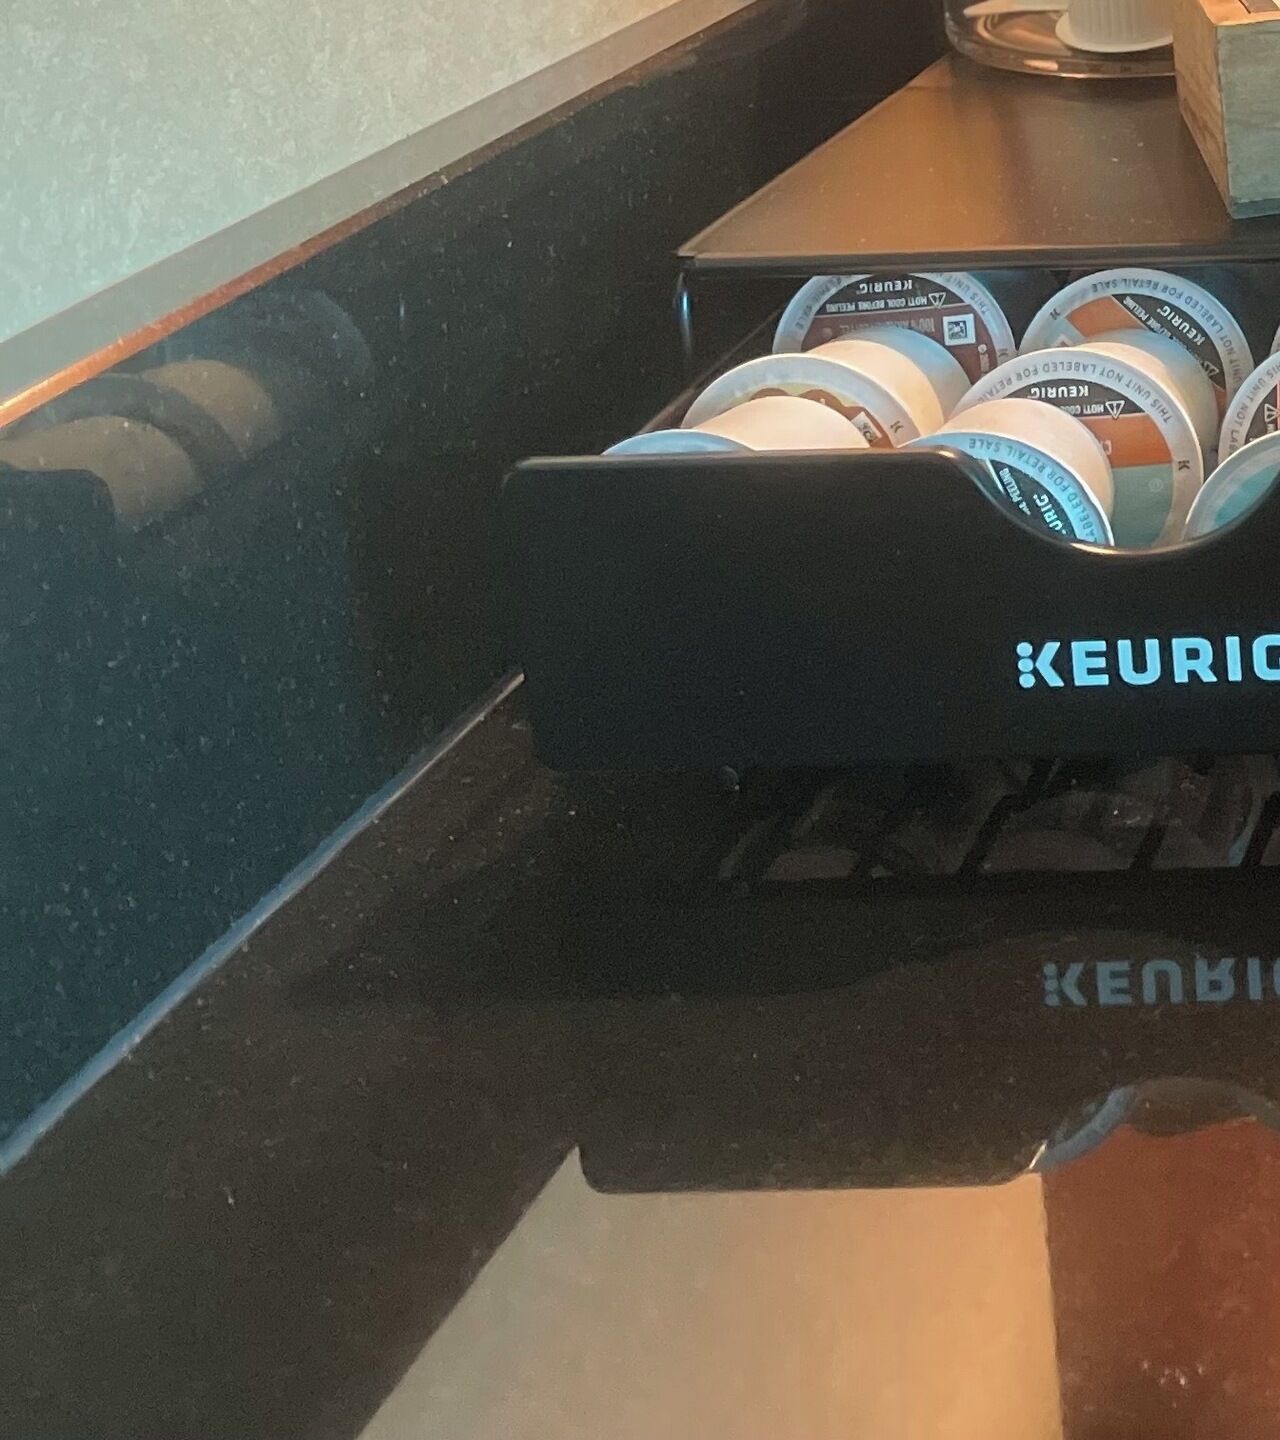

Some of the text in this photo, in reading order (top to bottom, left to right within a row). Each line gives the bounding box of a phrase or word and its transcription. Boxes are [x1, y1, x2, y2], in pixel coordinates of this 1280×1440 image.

[858, 279, 913, 294] KEURIG
[1160, 282, 1184, 300] FOR
[1157, 305, 1206, 346] KEURIG
[1015, 366, 1039, 380] FOR
[1042, 360, 1097, 373] LABELED
[1098, 366, 1124, 382] NOT
[1030, 385, 1089, 399] KEURIG
[1125, 376, 1151, 399] UNIT
[1149, 396, 1172, 423] THIS
[968, 438, 1001, 453] SALE
[1006, 444, 1046, 473] RETAIL
[1045, 471, 1071, 493] FOR
[1033, 494, 1067, 535] URIG
